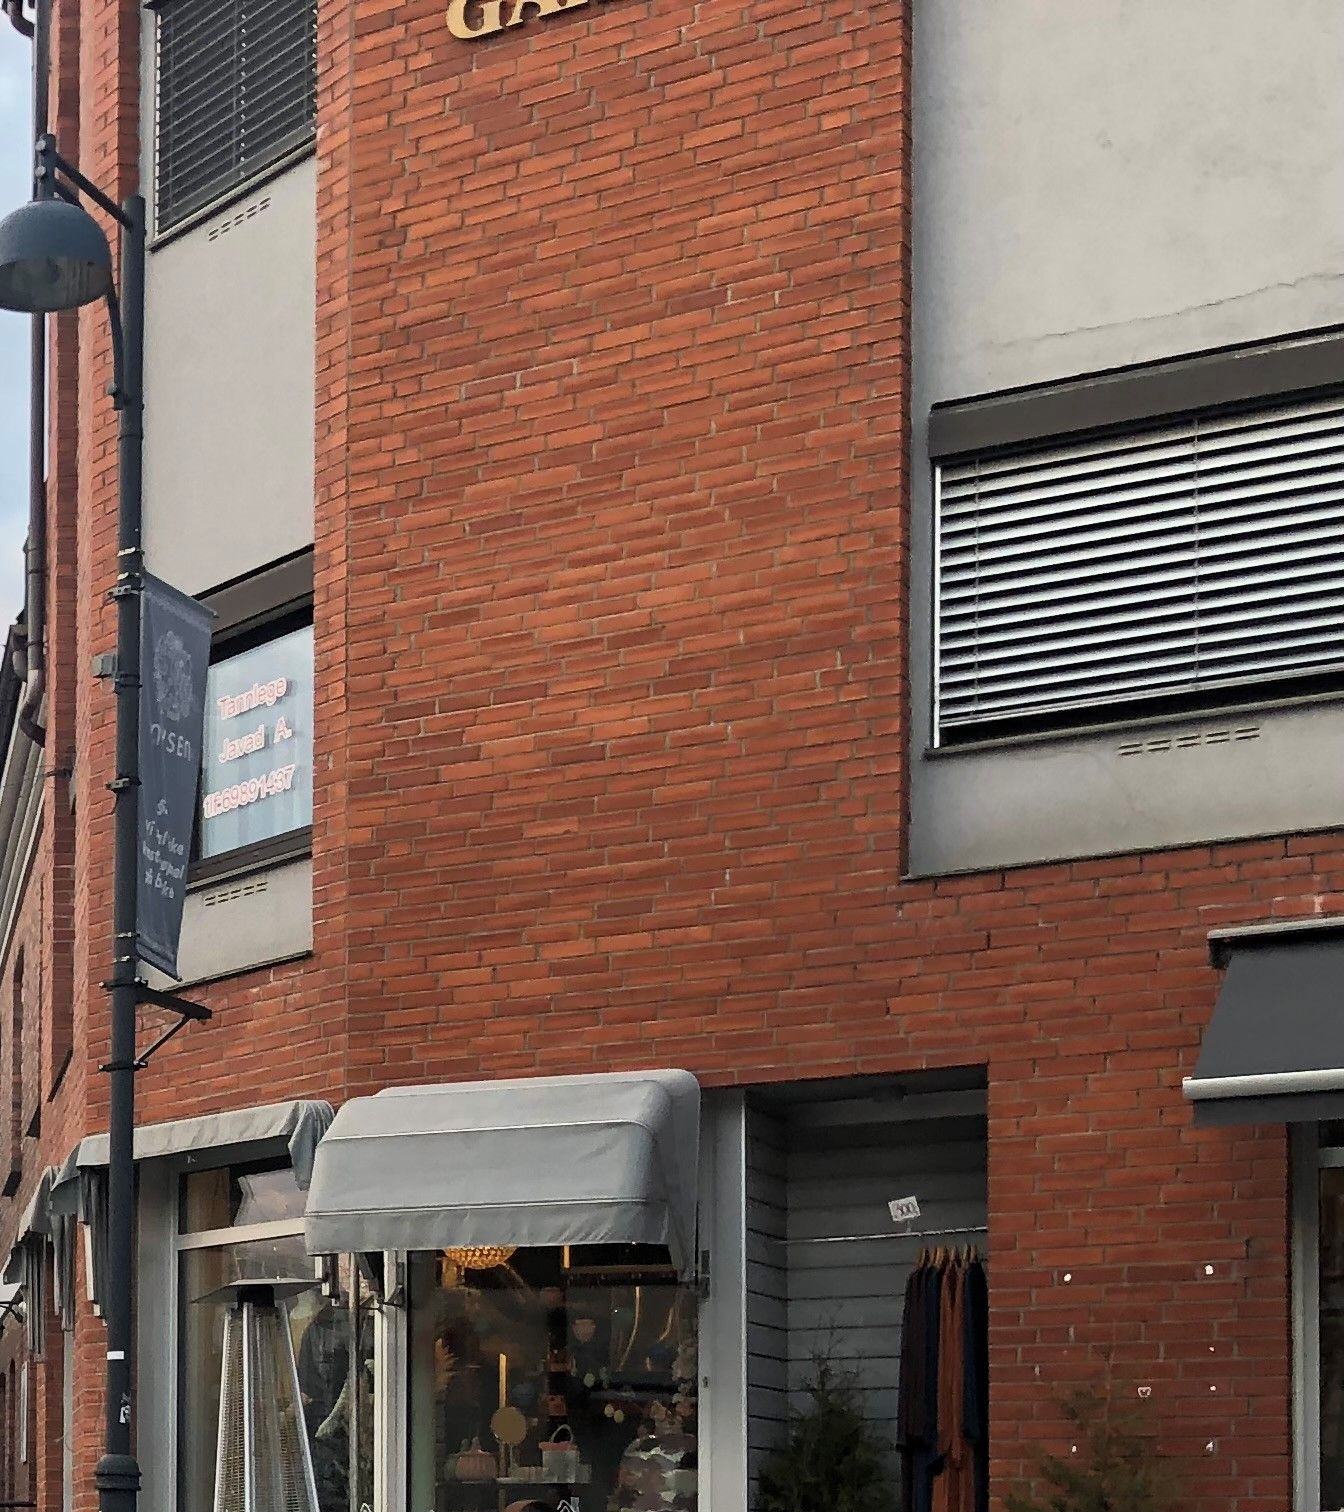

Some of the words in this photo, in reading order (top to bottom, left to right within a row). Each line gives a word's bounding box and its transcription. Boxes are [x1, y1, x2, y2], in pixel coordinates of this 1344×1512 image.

[217, 677, 288, 720] Tannlege
[218, 723, 265, 763] Javad
[273, 715, 293, 743] A.
